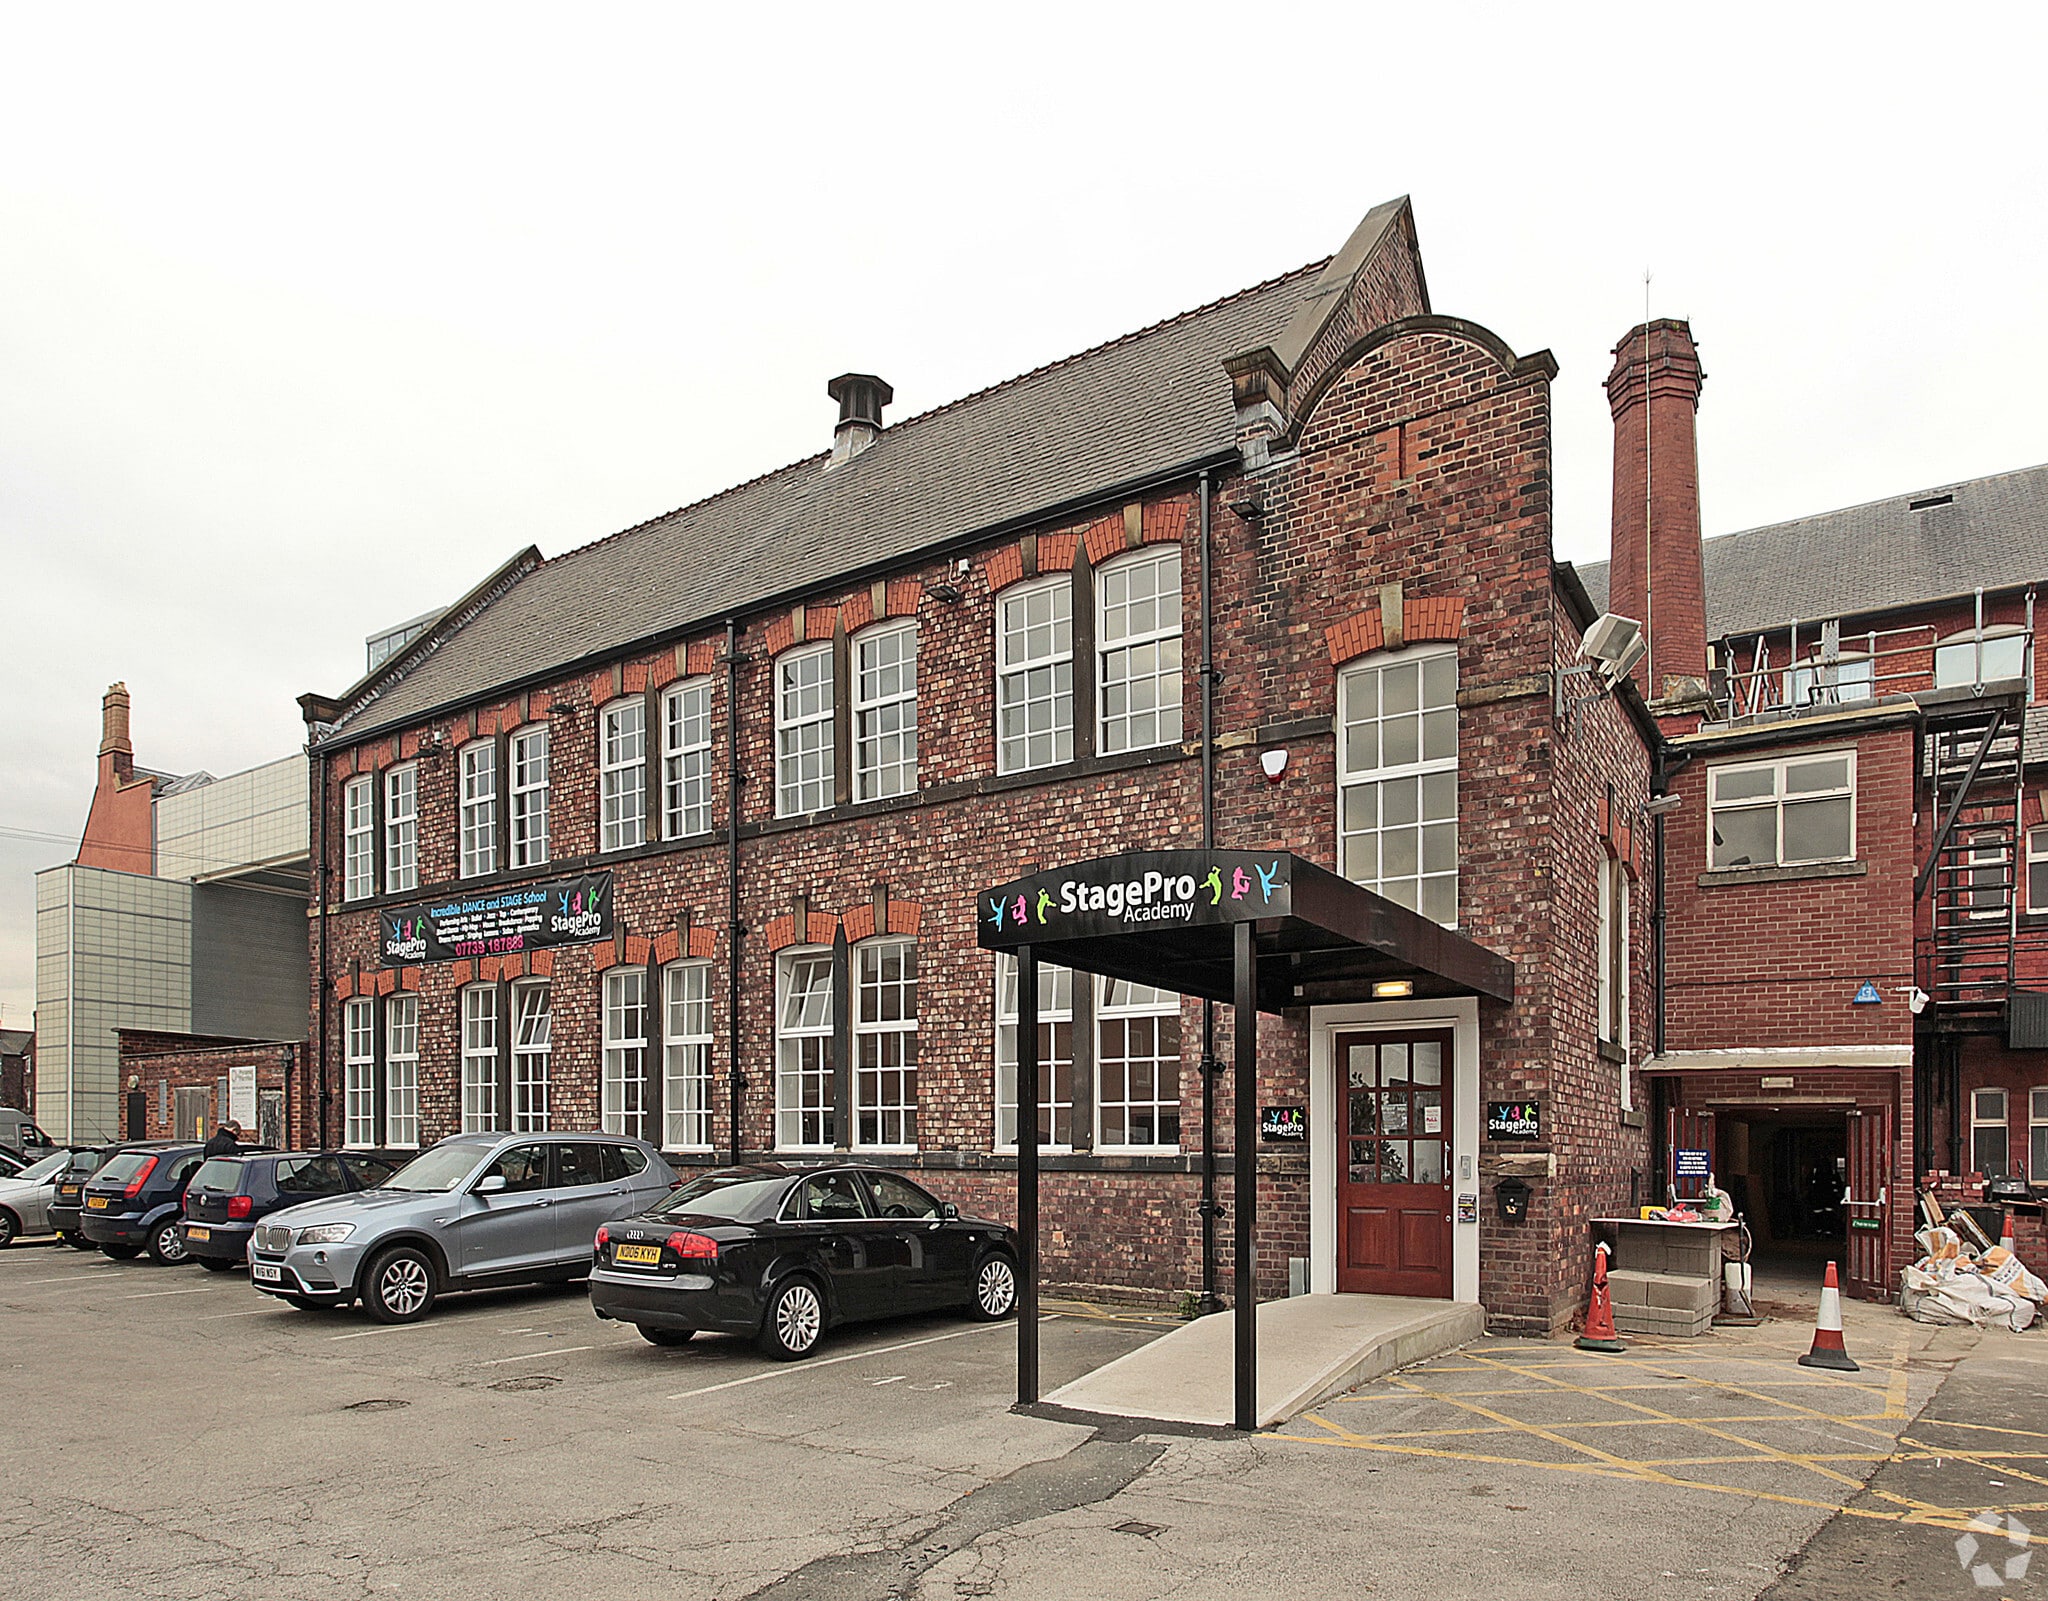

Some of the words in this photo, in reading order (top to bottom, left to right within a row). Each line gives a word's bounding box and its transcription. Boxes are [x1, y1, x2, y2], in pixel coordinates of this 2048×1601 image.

[431, 904, 460, 918] Incredible
[462, 900, 485, 913] DANCE
[486, 898, 500, 910] and
[501, 894, 523, 908] STAGE
[523, 890, 547, 904] School
[1060, 871, 1196, 917] StagePro
[1123, 900, 1194, 922] Academy
[551, 910, 601, 934] StagePro
[386, 937, 427, 957] StagePro
[1262, 1121, 1304, 1135] StagePro
[1489, 1119, 1538, 1133] StagePro
[639, 1247, 658, 1261] KYH
